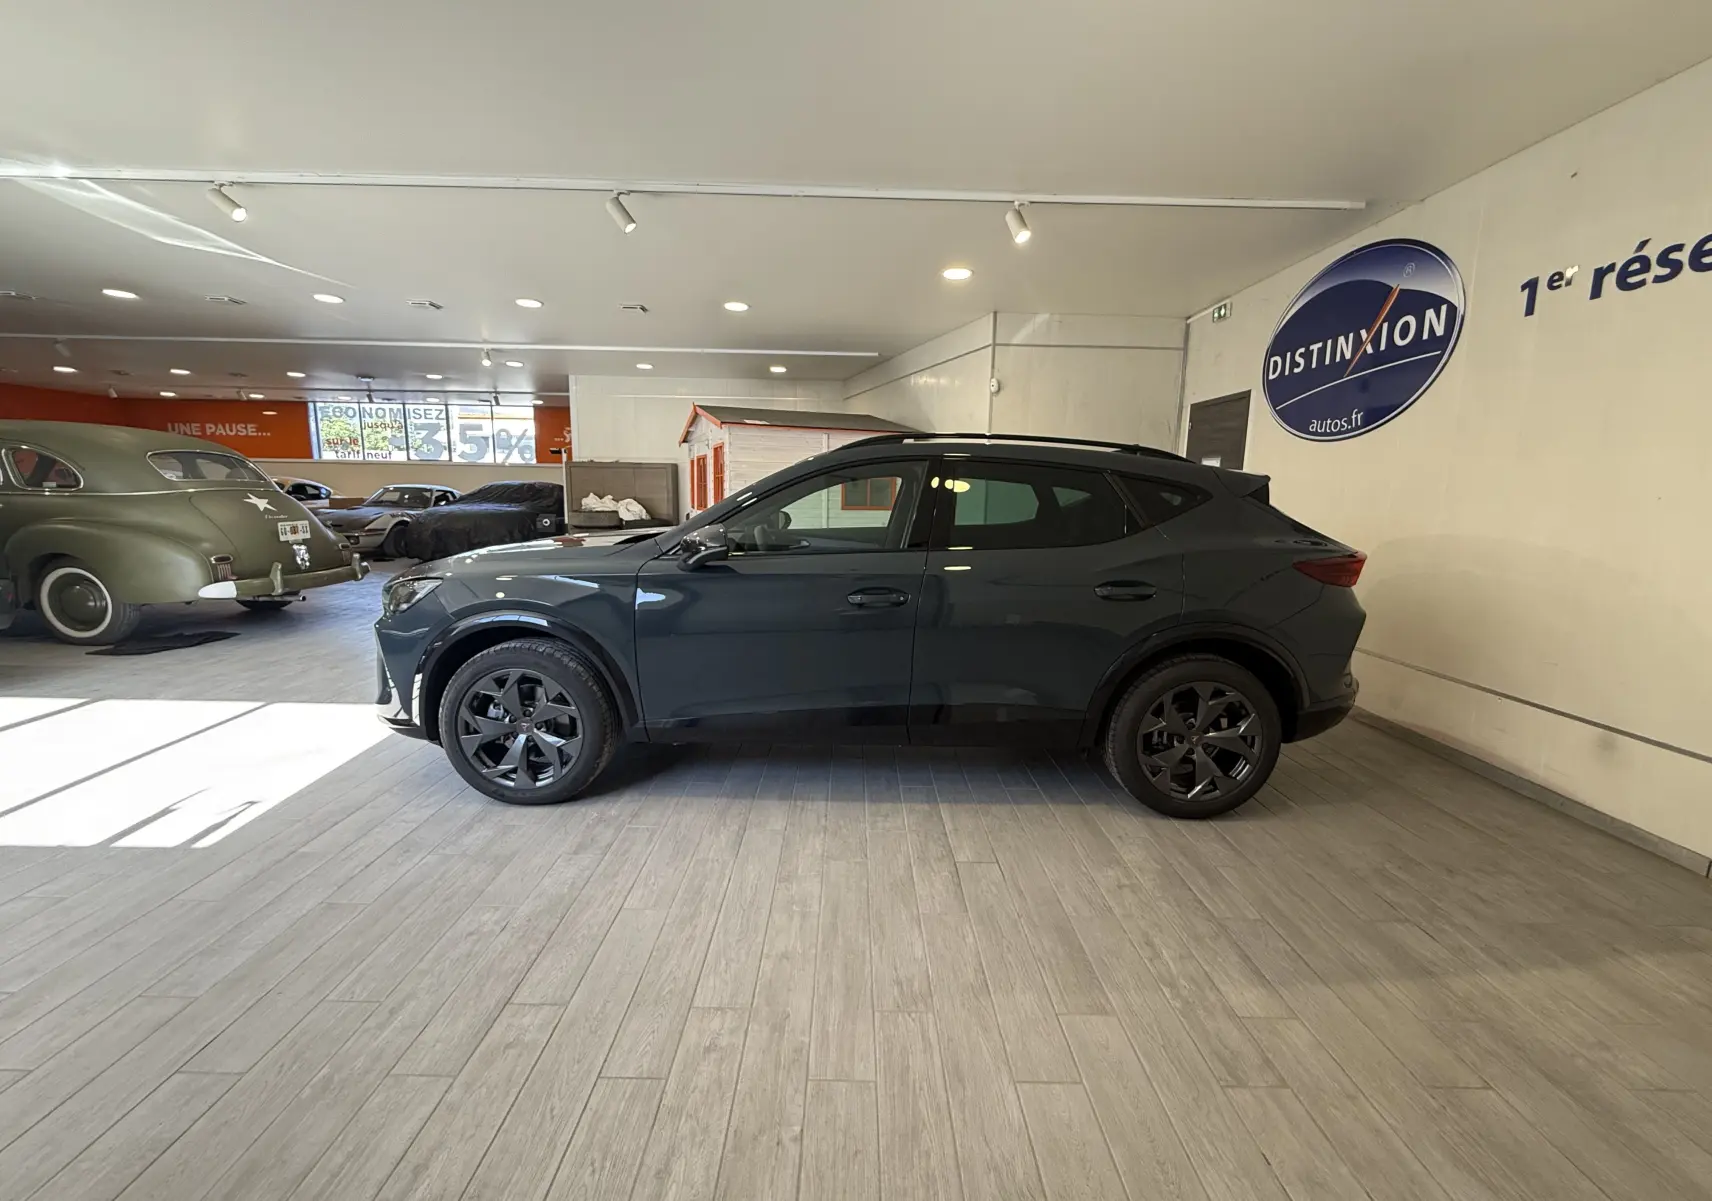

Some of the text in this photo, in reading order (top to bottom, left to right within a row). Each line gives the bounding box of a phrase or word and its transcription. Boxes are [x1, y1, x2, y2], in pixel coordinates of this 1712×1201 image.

[1519, 264, 1580, 317] 1er
[1267, 303, 1449, 381] DISTINXION
[167, 422, 202, 435] UNE
[1308, 408, 1364, 434] autos.fr
[325, 436, 360, 446] sur le
[335, 450, 393, 460] tarif neuf
